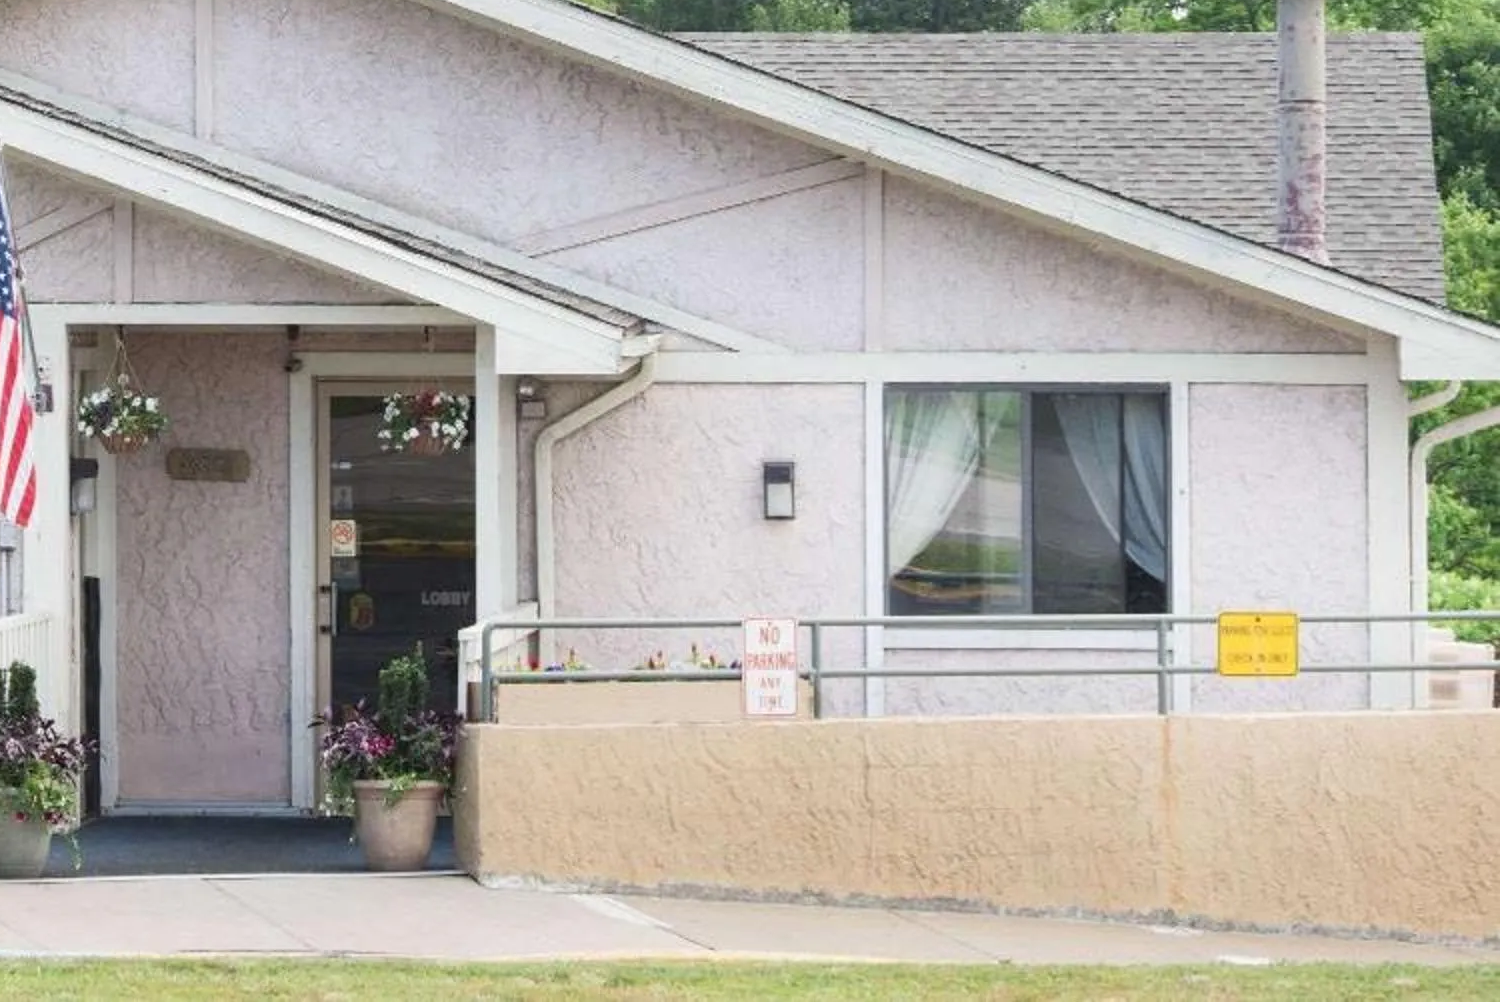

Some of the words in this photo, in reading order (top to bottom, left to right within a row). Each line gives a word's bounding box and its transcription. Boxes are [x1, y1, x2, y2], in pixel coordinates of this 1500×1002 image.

[421, 591, 471, 606] LOBBY
[759, 626, 781, 646] NO
[746, 652, 795, 671] PARKING
[759, 677, 781, 689] ANY
